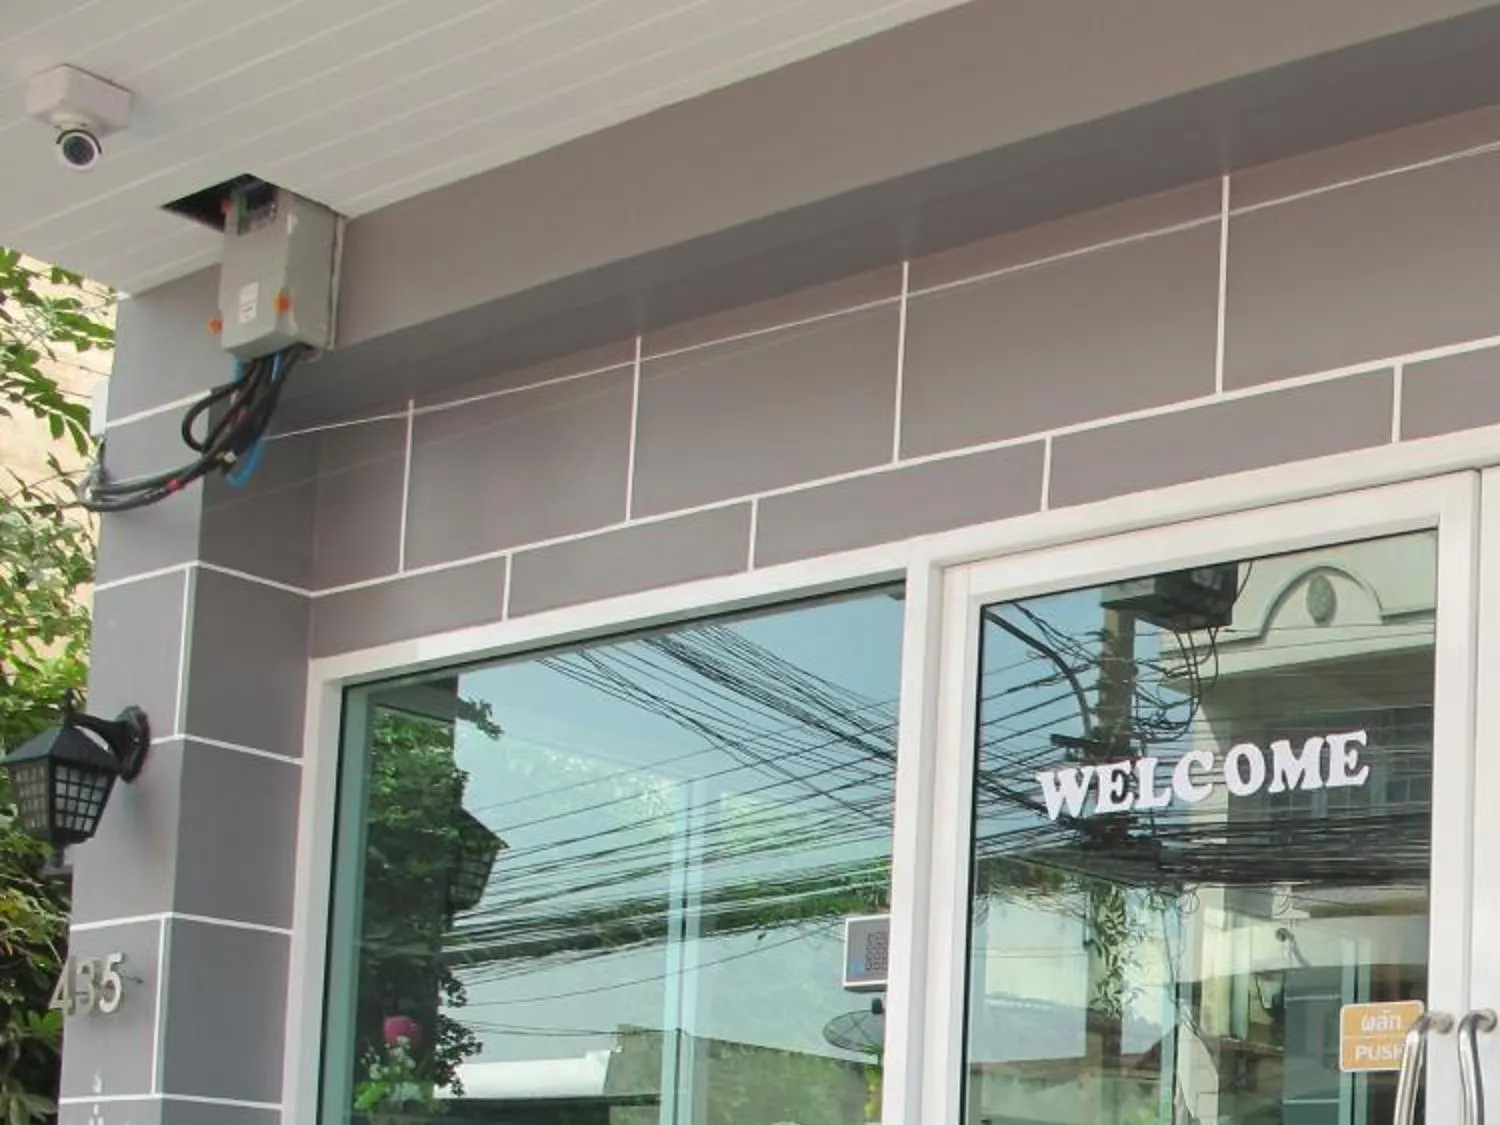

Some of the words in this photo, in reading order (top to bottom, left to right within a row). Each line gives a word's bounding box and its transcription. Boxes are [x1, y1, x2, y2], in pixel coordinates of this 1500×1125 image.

[1036, 730, 1370, 821] WELCOME
[48, 952, 122, 1016] 435
[1361, 1009, 1402, 1031] ผลัก
